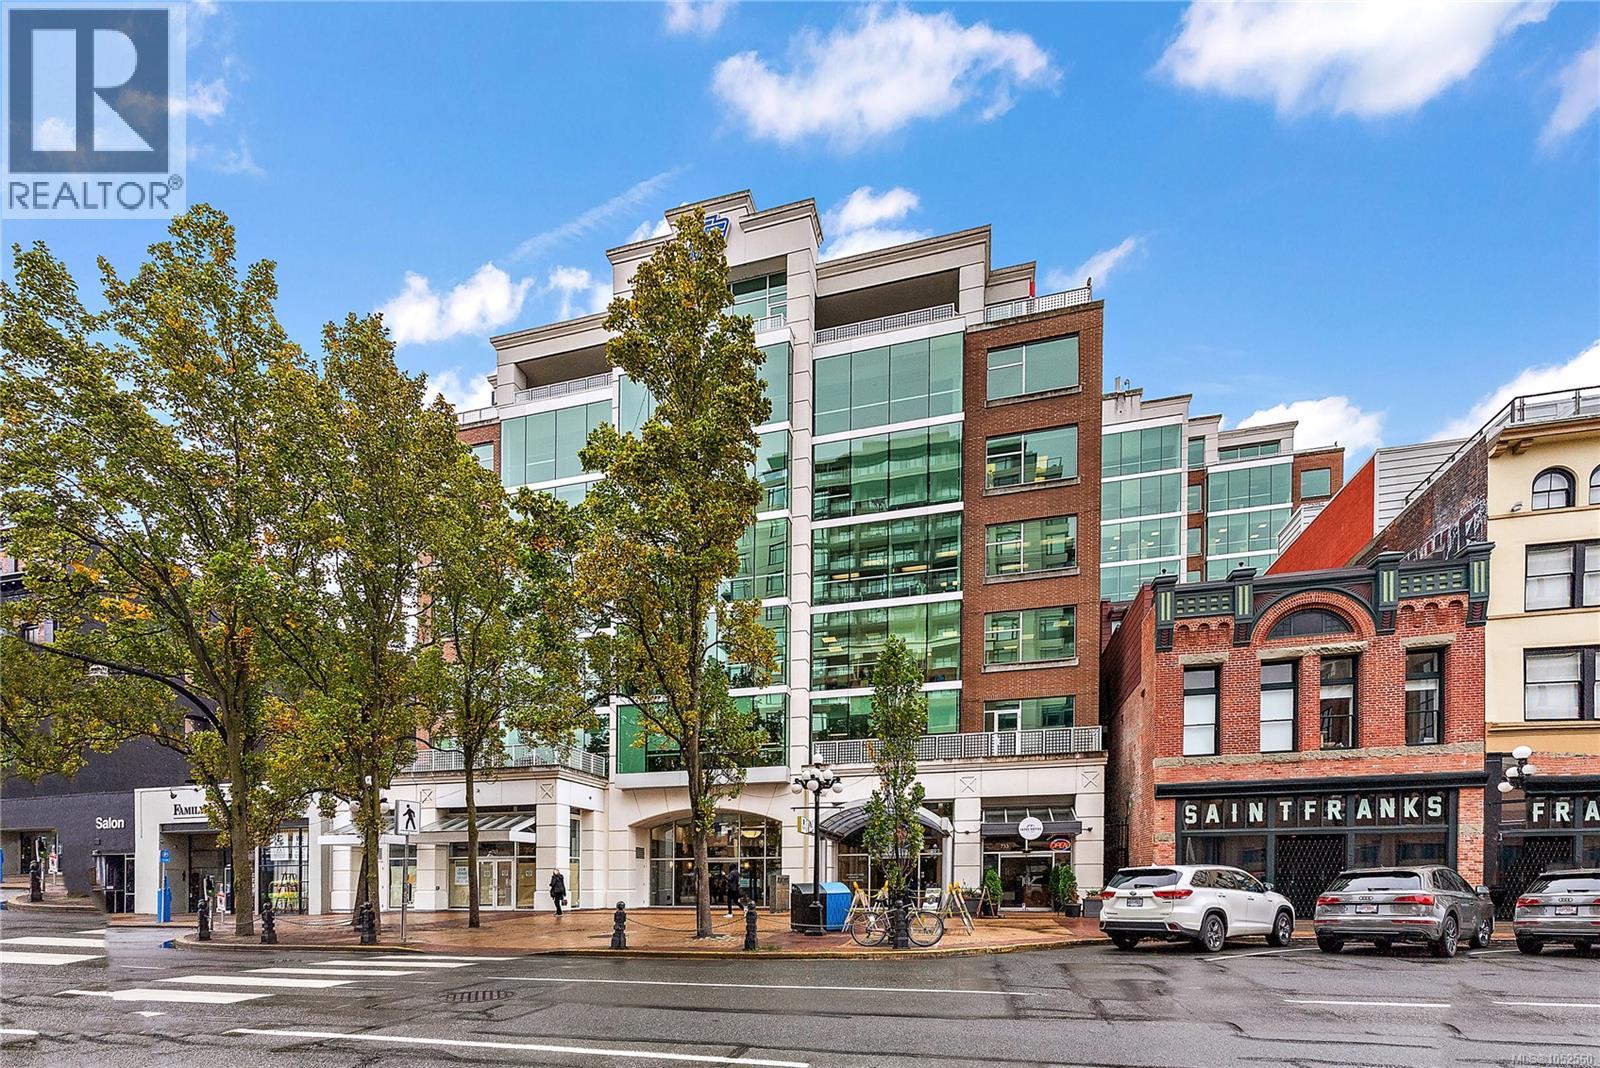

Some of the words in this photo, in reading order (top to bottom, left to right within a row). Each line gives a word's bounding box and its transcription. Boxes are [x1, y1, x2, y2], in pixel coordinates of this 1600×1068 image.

[1532, 800, 1600, 823] FRA
[95, 816, 125, 830] Salon
[1049, 840, 1070, 849] OPEN
